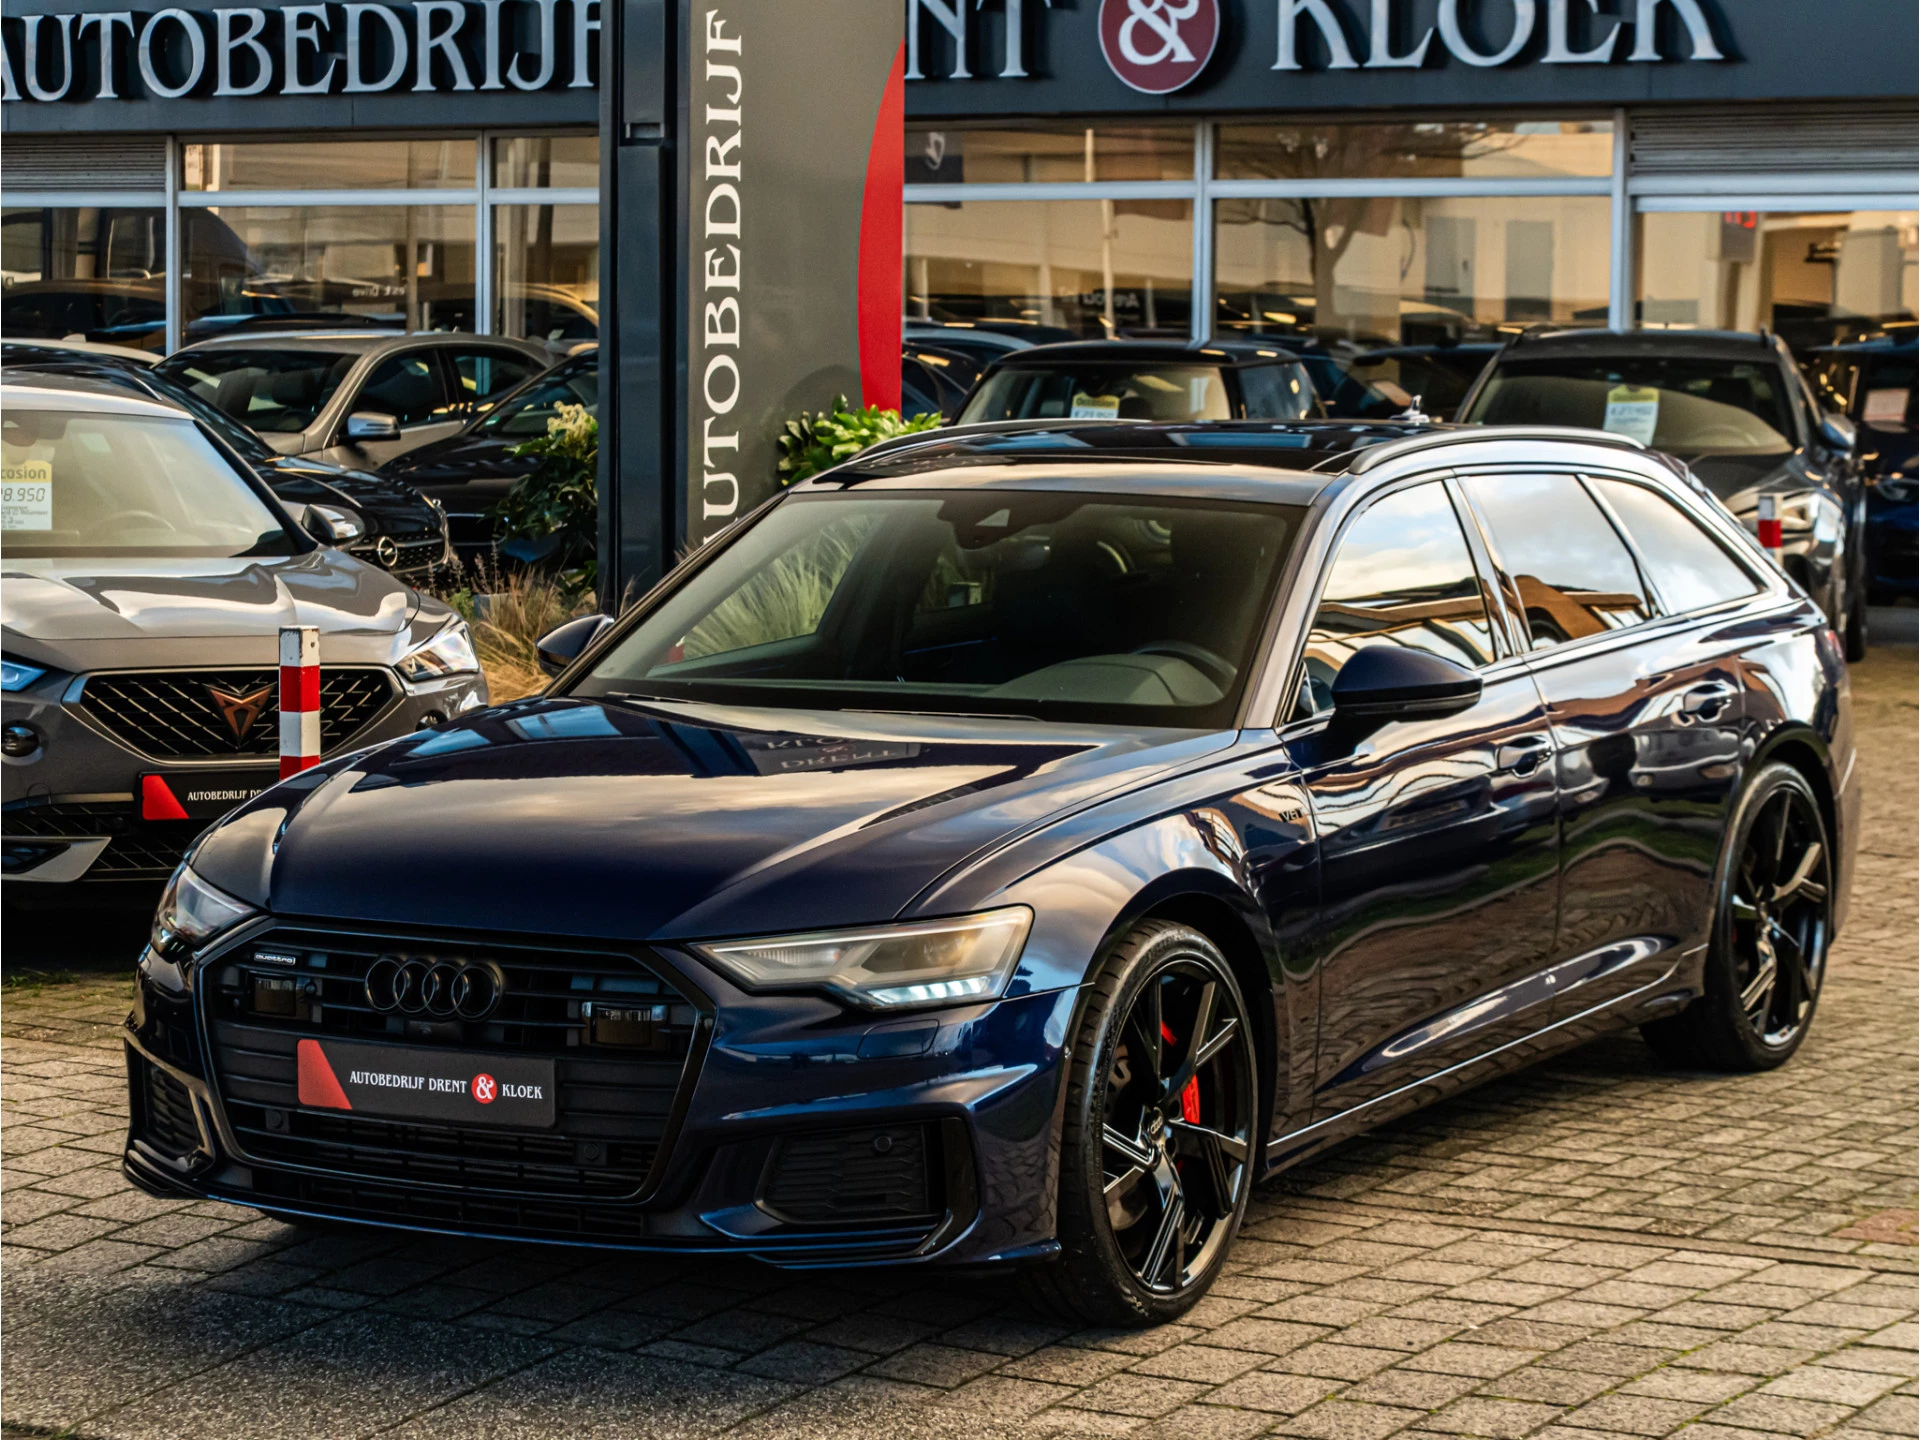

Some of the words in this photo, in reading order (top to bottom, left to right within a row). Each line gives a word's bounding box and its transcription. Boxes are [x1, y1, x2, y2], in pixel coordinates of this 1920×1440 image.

[1117, 0, 1200, 64] &
[1270, 0, 1725, 71] KLOEK
[1, 487, 46, 502] 8.950
[187, 789, 247, 801] AUTOBEDRIJF
[255, 954, 293, 964] quattro
[349, 1070, 425, 1090] AUTOBEDRIJF
[428, 1077, 467, 1094] DRENT
[476, 1076, 494, 1100] &
[502, 1083, 543, 1100] KLOEK
